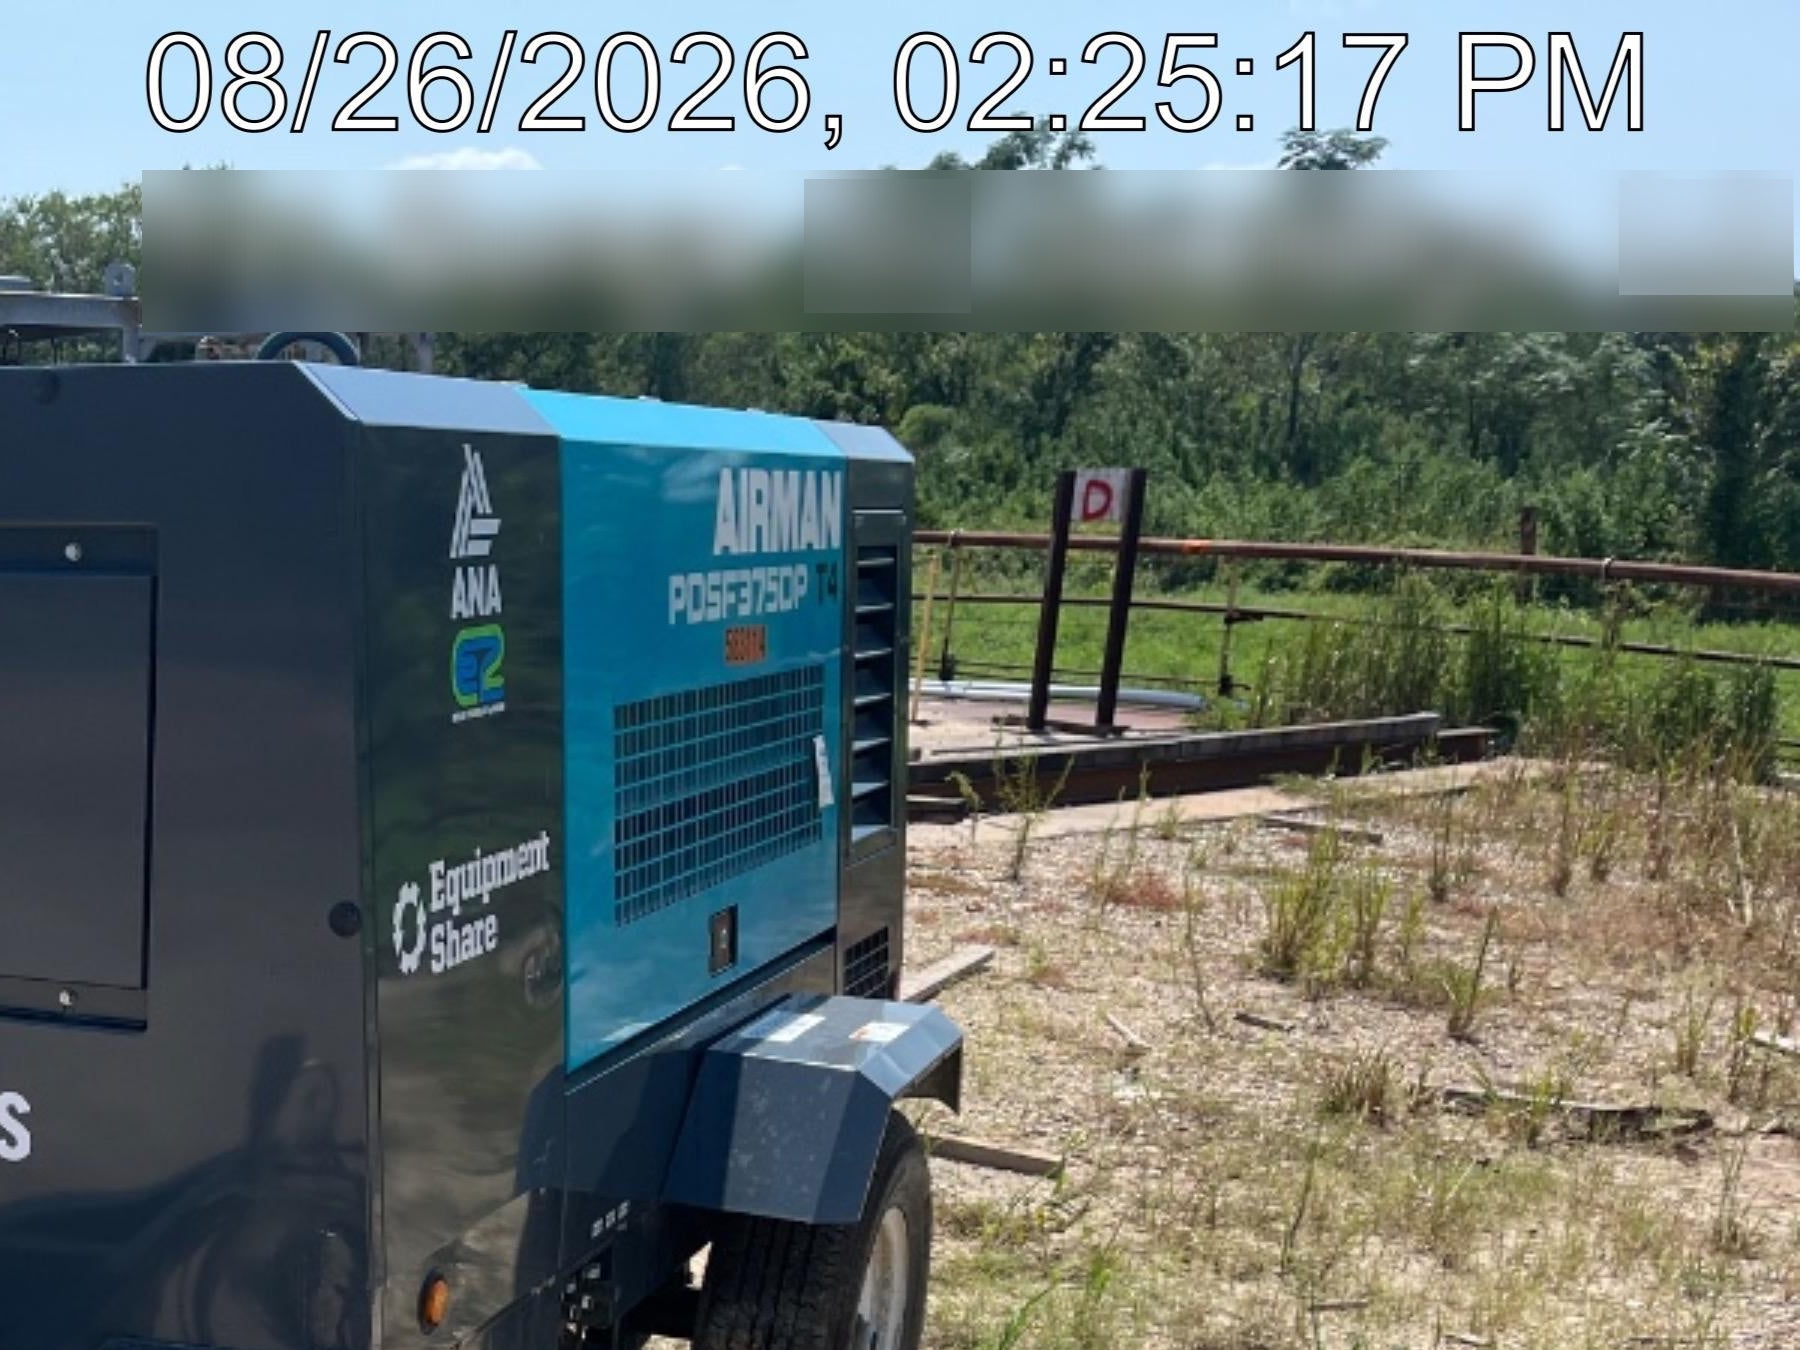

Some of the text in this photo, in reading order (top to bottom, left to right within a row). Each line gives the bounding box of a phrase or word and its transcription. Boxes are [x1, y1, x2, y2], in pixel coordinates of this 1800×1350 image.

[712, 467, 842, 556] AIRMAN
[1080, 478, 1114, 523] D
[450, 564, 503, 619] ANA
[428, 829, 551, 916] Equipment
[430, 913, 500, 974] Share
